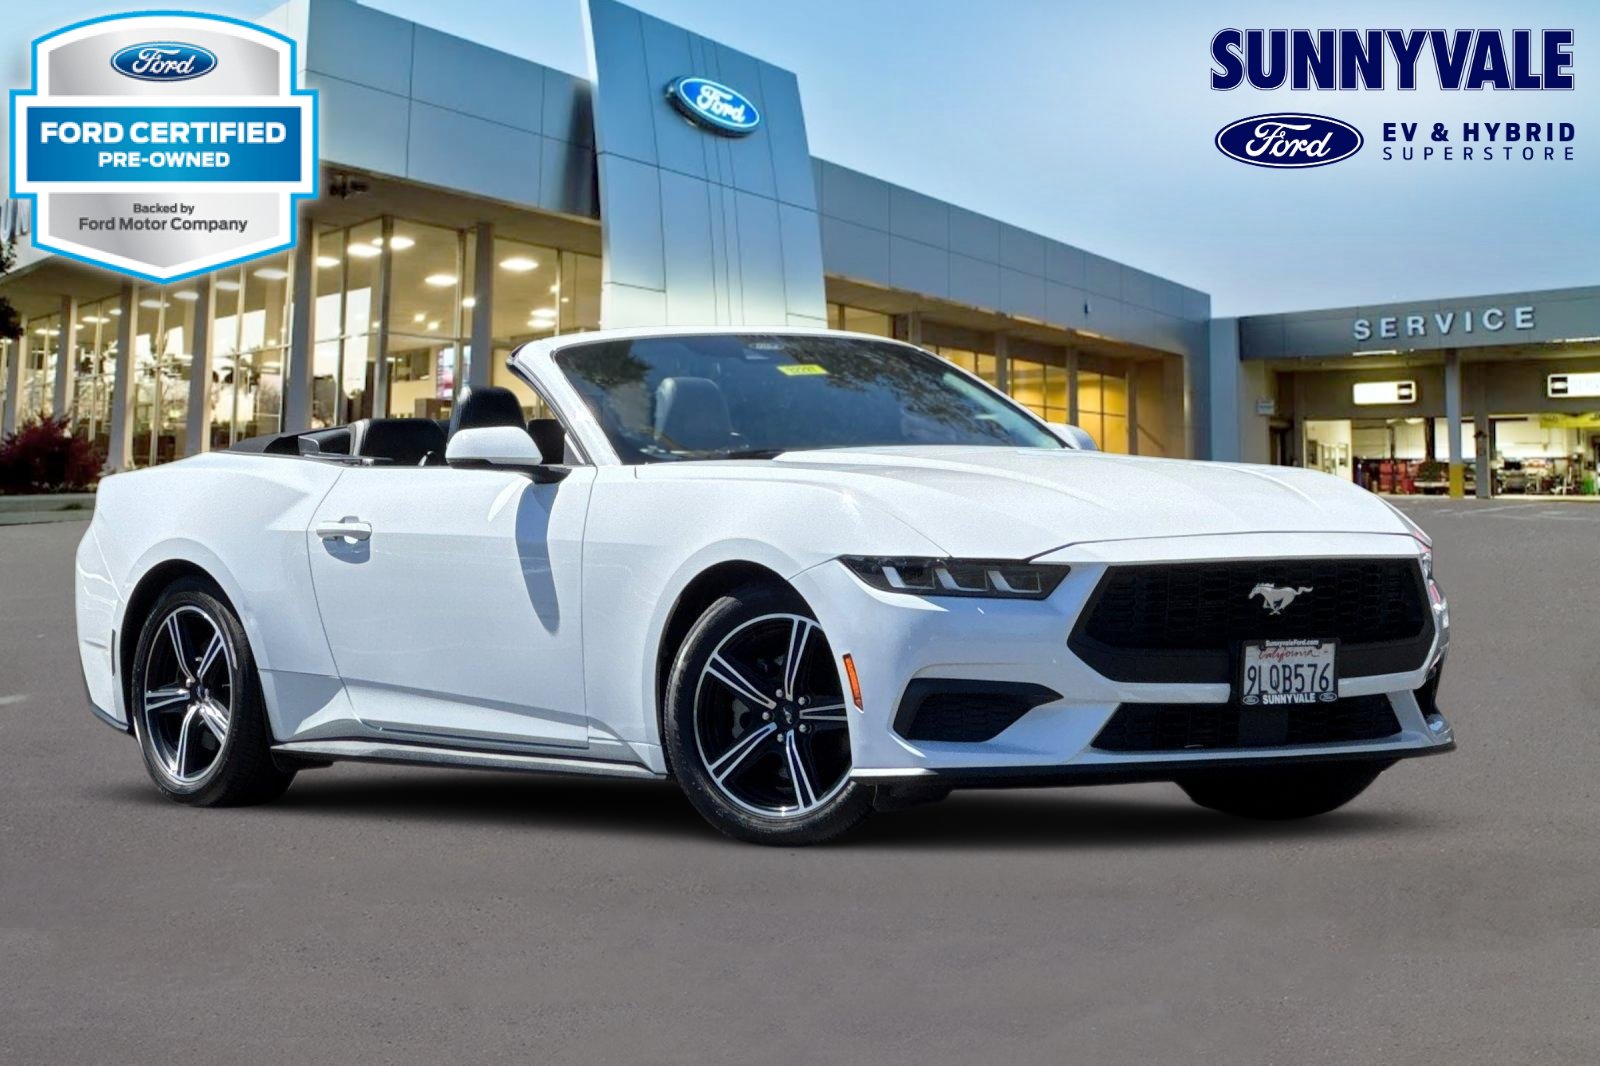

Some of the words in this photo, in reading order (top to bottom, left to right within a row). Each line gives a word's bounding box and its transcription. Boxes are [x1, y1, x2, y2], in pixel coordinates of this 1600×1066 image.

[696, 84, 746, 123] Ford
[1353, 305, 1536, 342] SERVICE
[1259, 646, 1319, 662] California
[1262, 692, 1316, 705] SUNNYVALE
